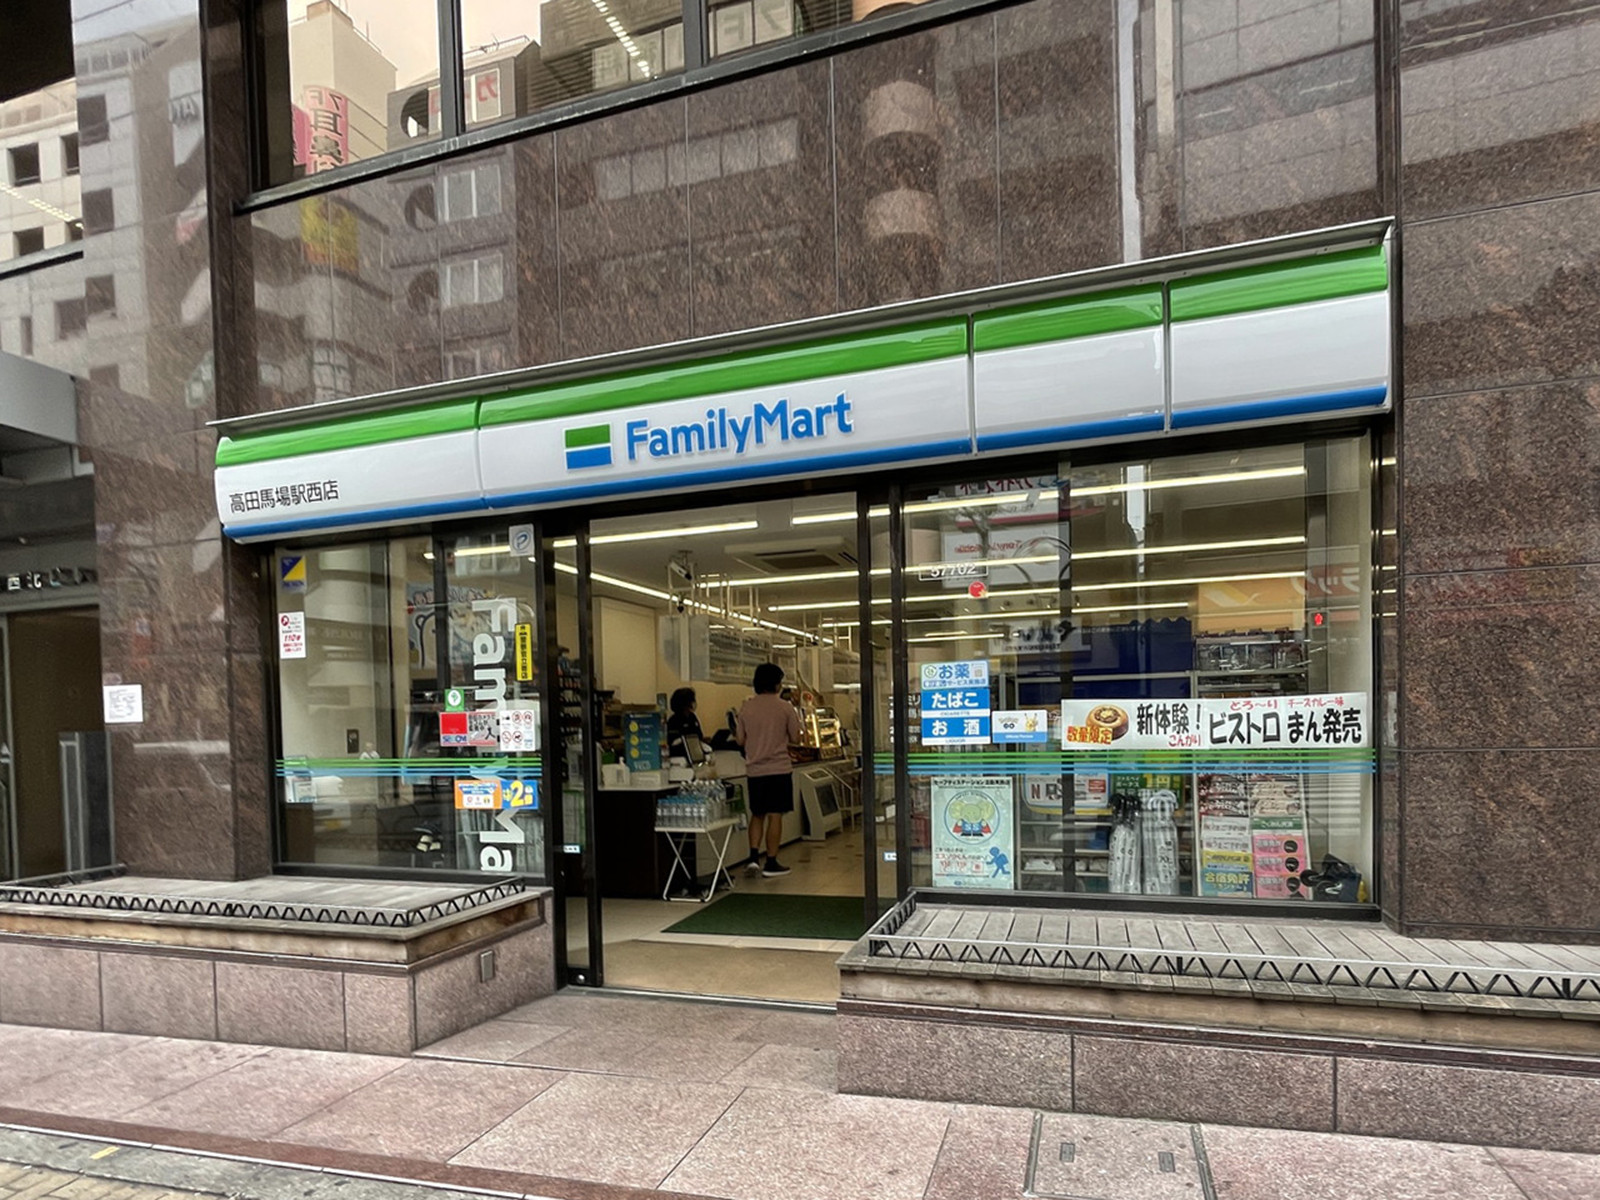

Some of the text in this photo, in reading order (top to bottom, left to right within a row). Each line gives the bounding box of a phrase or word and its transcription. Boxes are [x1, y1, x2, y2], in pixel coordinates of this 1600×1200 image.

[625, 392, 853, 461] FamilyMart
[229, 480, 339, 513] 高田馬場駅西店
[939, 664, 970, 679] お薬
[931, 692, 979, 708] たばこ
[932, 719, 980, 736] お酒
